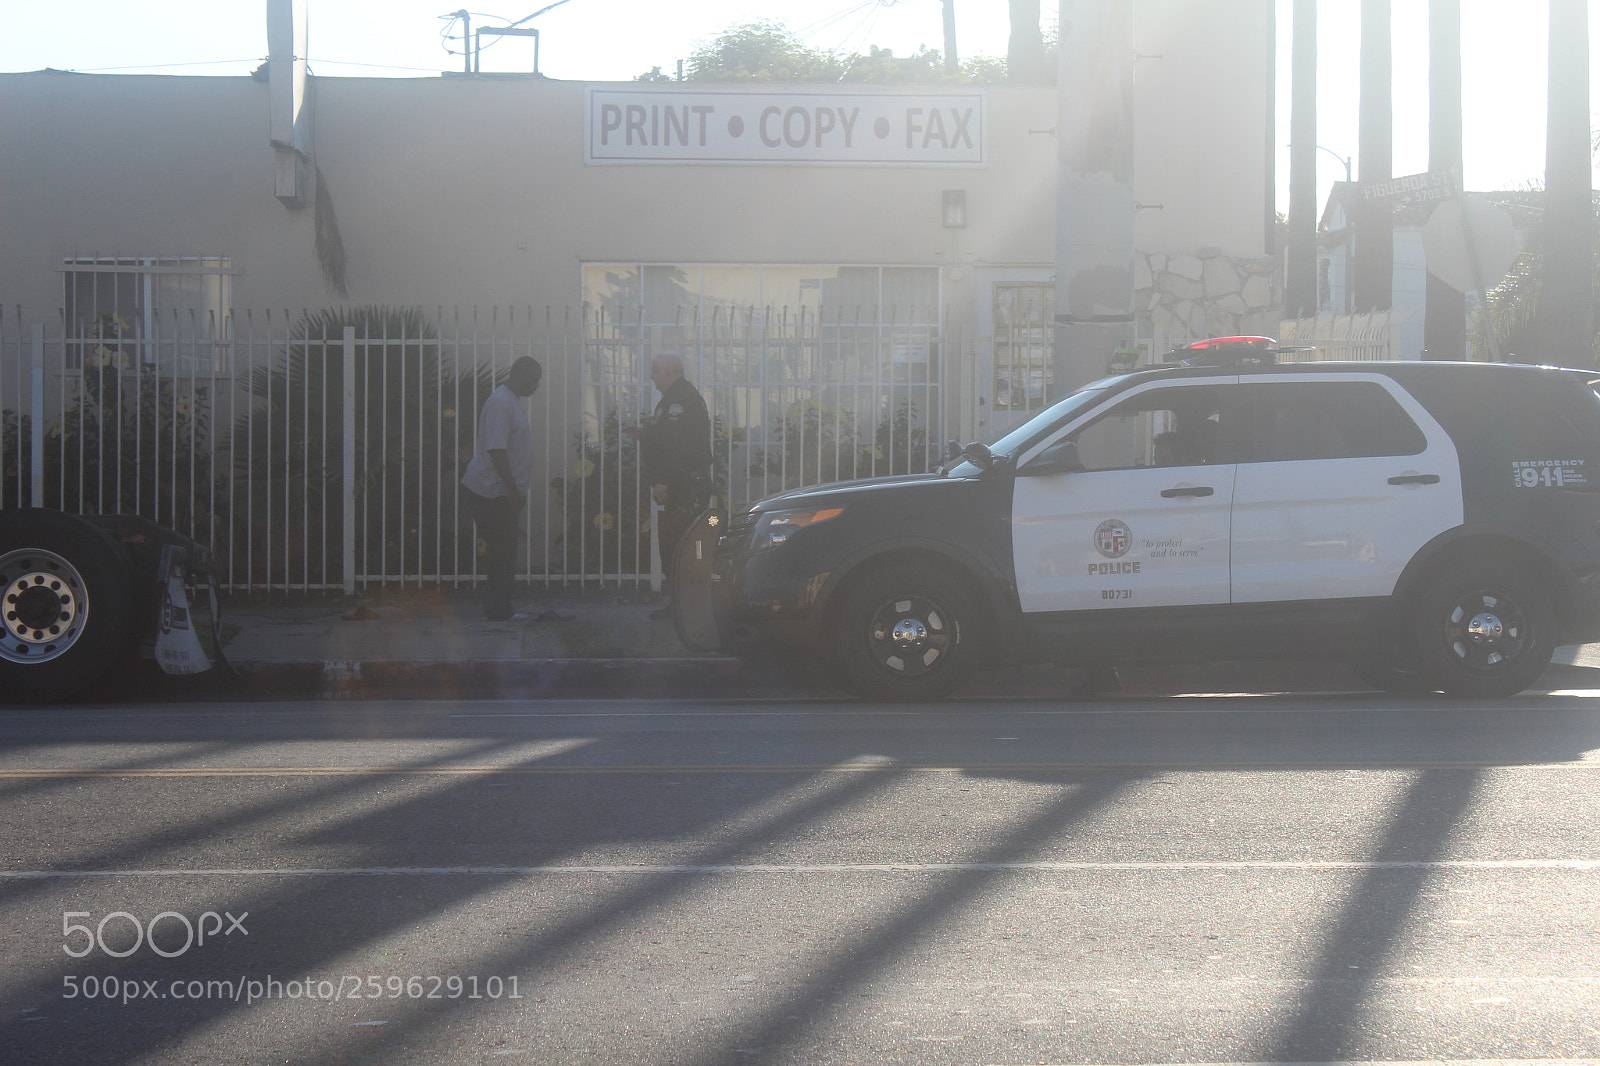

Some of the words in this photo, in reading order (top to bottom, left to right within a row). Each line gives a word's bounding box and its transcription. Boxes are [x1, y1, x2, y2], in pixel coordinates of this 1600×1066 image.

[600, 104, 714, 147] PRINT
[758, 105, 860, 150] COPY
[905, 107, 974, 150] FAX
[1364, 175, 1428, 200] FIGUEROA
[1513, 468, 1522, 487] CALL
[1521, 467, 1564, 487] 9-1-1
[1156, 539, 1183, 550] protect
[1150, 549, 1166, 558] and
[1169, 549, 1177, 557] to
[1088, 561, 1141, 575] POLICE
[1102, 589, 1132, 599] 80731
